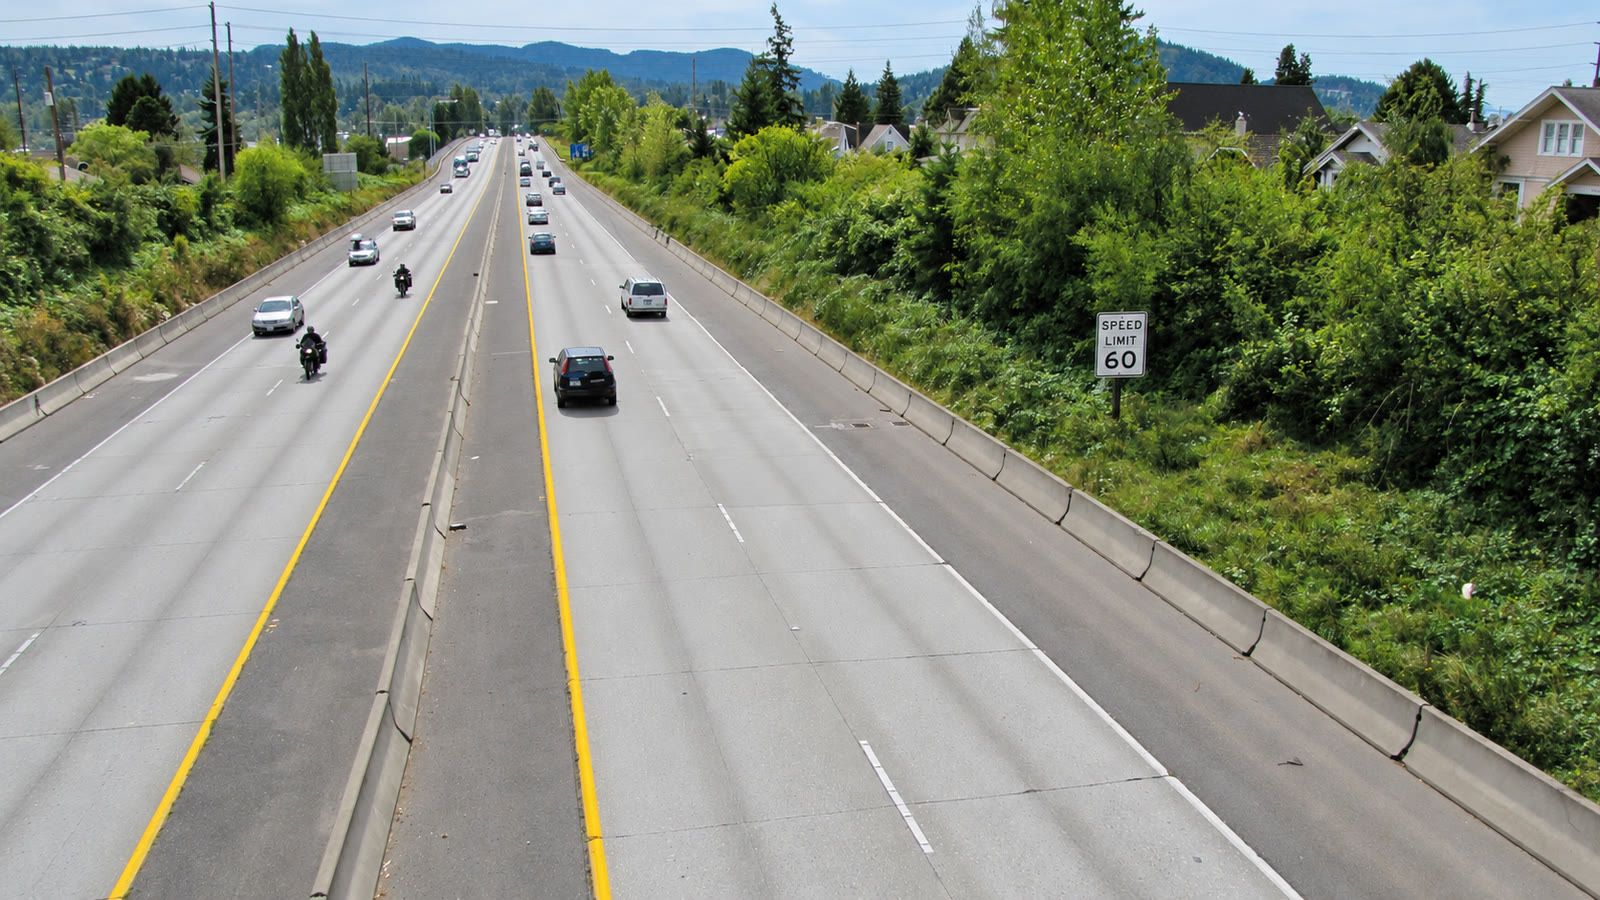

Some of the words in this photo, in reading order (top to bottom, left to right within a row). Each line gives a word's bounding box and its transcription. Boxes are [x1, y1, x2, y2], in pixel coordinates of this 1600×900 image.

[1102, 320, 1142, 330] SPEED
[1105, 335, 1137, 346] LIMIT
[1105, 350, 1136, 369] 60
